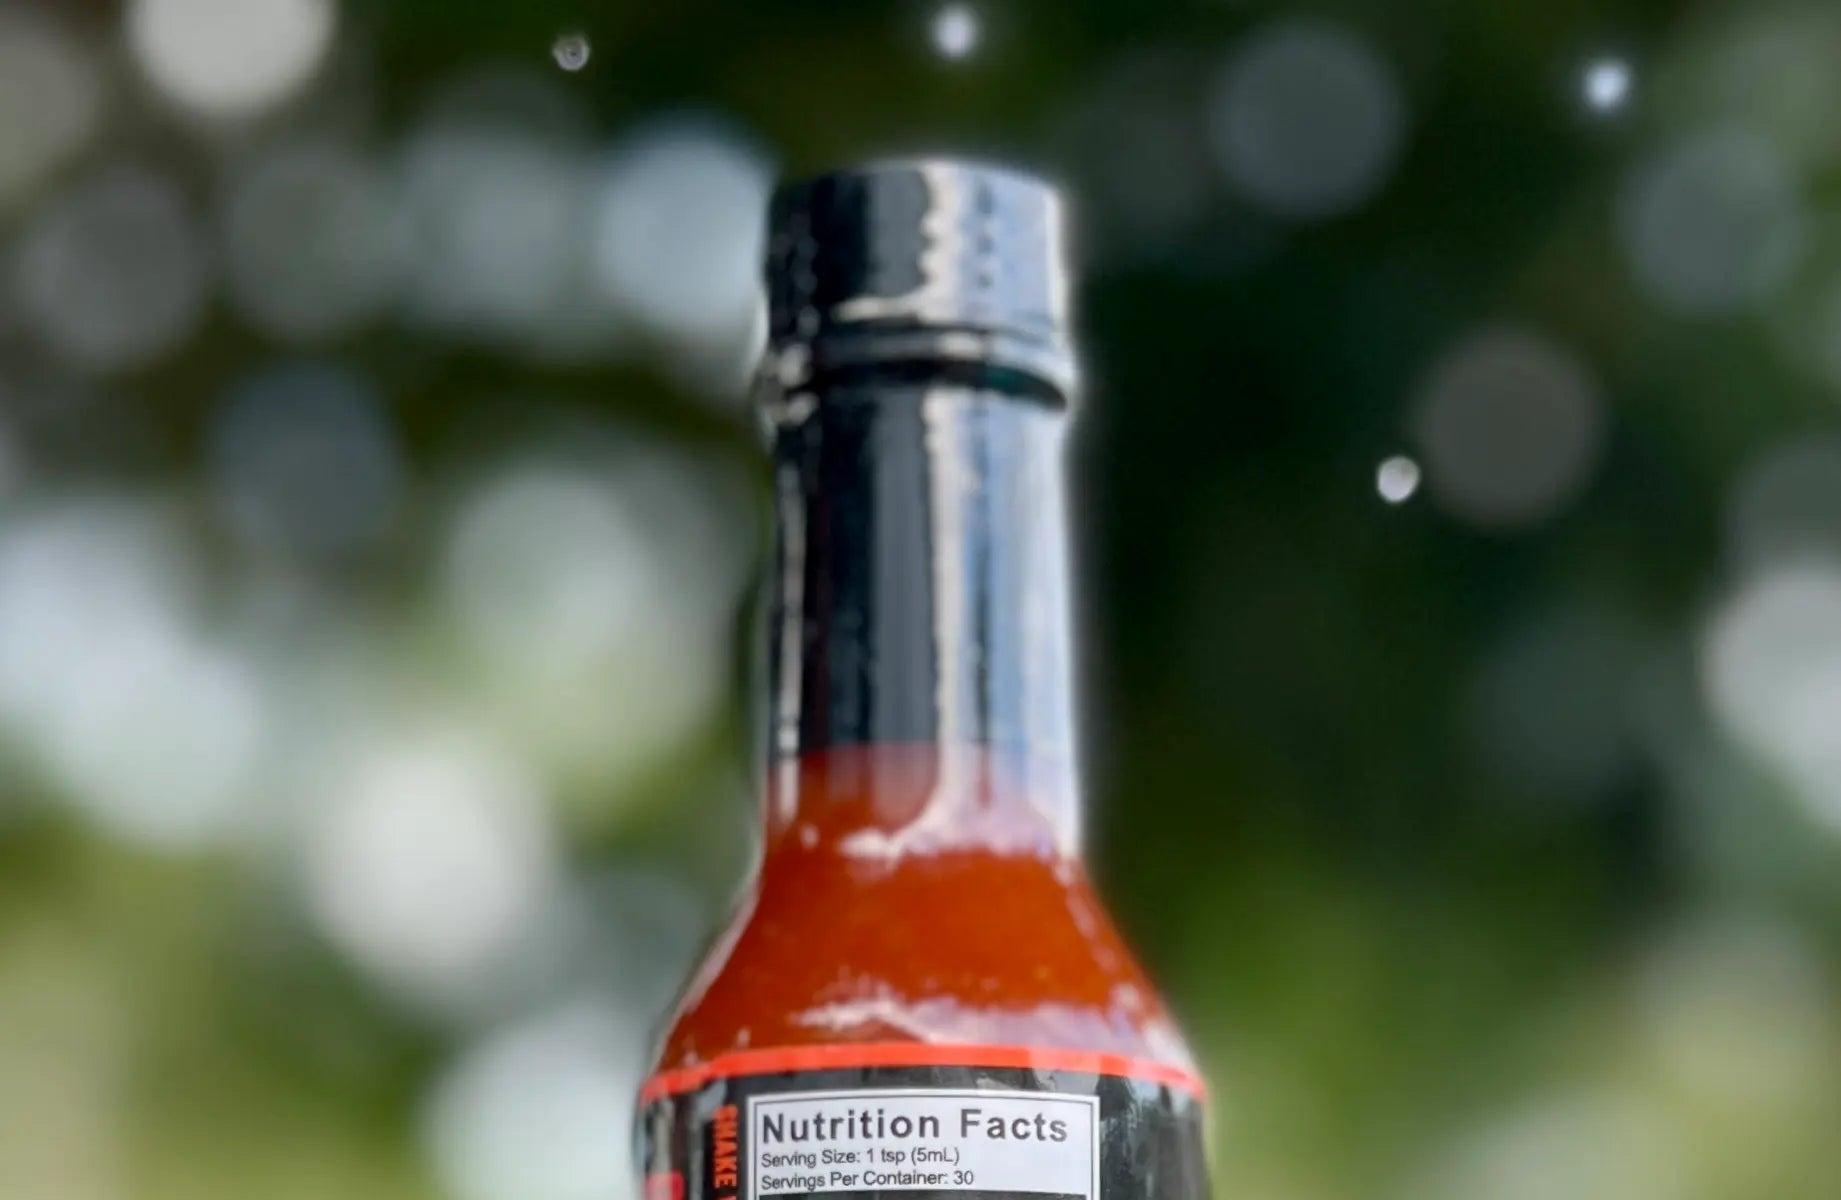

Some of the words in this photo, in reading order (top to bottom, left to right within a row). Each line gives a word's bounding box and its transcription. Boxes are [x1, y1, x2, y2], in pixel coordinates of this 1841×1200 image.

[763, 1109, 939, 1144] Nutrition
[961, 1109, 1067, 1142] Facts
[713, 1105, 738, 1188] SHAKE
[761, 1152, 816, 1168] Serving
[822, 1149, 860, 1164] Size:
[867, 1148, 873, 1163] 1
[881, 1148, 905, 1165] tsp
[911, 1147, 959, 1166] (5mL)
[762, 1173, 825, 1190] Servings
[830, 1171, 859, 1186] Per
[863, 1170, 947, 1185] Container:
[953, 1170, 974, 1185] 30
